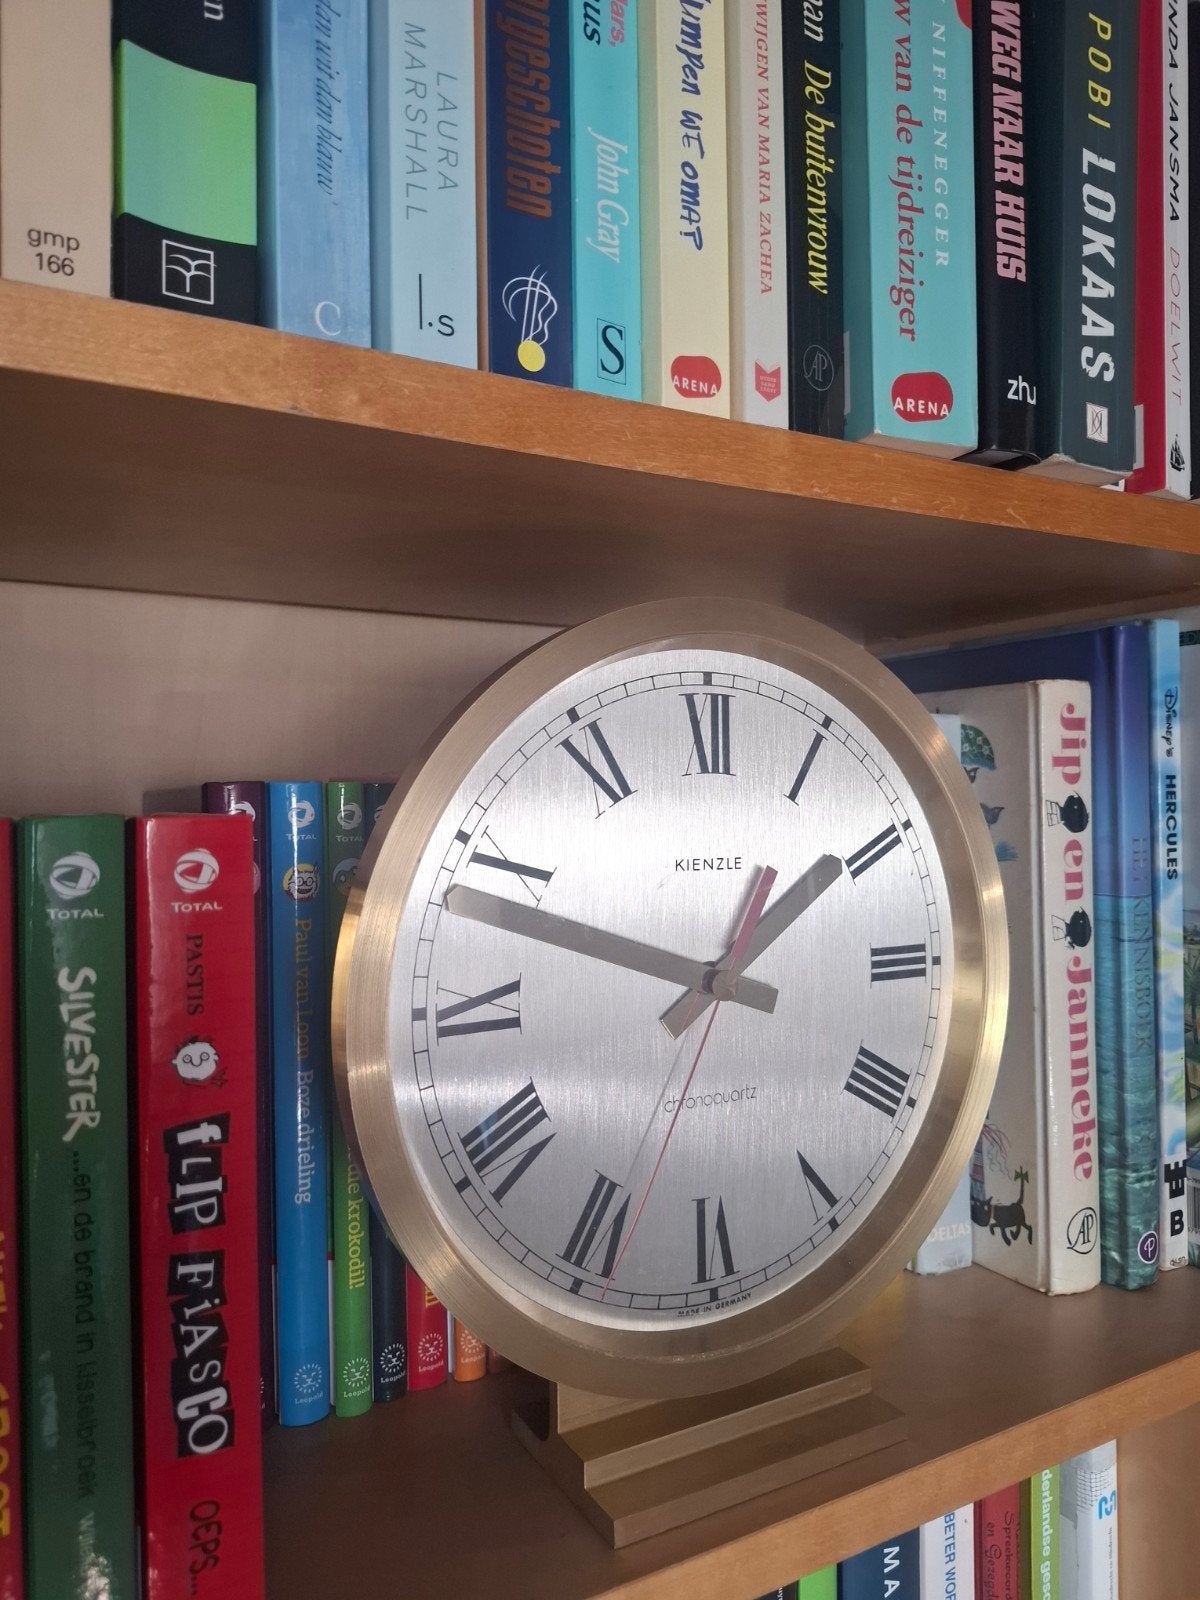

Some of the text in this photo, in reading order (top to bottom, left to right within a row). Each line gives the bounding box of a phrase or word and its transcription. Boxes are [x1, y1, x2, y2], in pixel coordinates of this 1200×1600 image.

[314, 0, 342, 39] dan
[583, 0, 601, 45] us
[804, 61, 831, 103] De
[895, 35, 912, 92] van
[1088, 13, 1111, 129] POBI
[314, 77, 343, 125] dan
[404, 22, 428, 221] MARSHALL
[895, 104, 922, 145] de
[437, 71, 459, 190] LAURA
[753, 0, 773, 295] WIJGEN VAN MARIA ZACHEA
[931, 21, 950, 268] NIFFENEGGER
[990, 1, 1027, 283] WEG NAAR HUIS
[1167, 84, 1180, 222] JANSMA
[586, 127, 629, 263] John Gray
[804, 103, 836, 295] buitenvrouw
[27, 228, 80, 252] gmp
[34, 252, 75, 277] 166
[889, 155, 925, 343] tijdreiziger
[1081, 148, 1116, 382] LOKAAS
[600, 324, 625, 375] S
[1168, 246, 1182, 406] DOELWIT
[672, 372, 720, 396] ARENA
[893, 395, 949, 418] ARENA
[678, 693, 736, 777] XII
[556, 716, 639, 819] XI
[286, 833, 317, 841] TOTAL
[1165, 774, 1179, 881] HERCULES
[674, 856, 743, 874] KIENZLE
[46, 907, 104, 921] TOTAL
[171, 901, 223, 913] TOTAL
[294, 918, 313, 963] Paul
[869, 942, 928, 988] III
[1052, 703, 1096, 1182] Jip en Janneke
[185, 933, 205, 1016] PASTIS
[296, 967, 310, 1004] van
[1132, 896, 1151, 1049] KENNISBOEK
[435, 972, 523, 1046] IX
[57, 966, 101, 1142] SILVESTER
[297, 1070, 314, 1119] Boze
[664, 1083, 757, 1113] chronoquartz
[294, 1121, 316, 1205] drieling
[457, 1076, 557, 1208] VIII
[73, 1211, 92, 1242] de
[347, 1196, 365, 1289] krokodil!
[555, 1169, 632, 1281] VII
[692, 1195, 740, 1285] VI
[74, 1249, 96, 1323] brand
[678, 1291, 751, 1318] MADE IN GERMANY
[75, 1330, 95, 1353] in
[418, 1360, 444, 1373] Leopold
[295, 1392, 324, 1405] Leopold
[343, 1386, 371, 1398] Leopold
[380, 1371, 406, 1384] Leopold
[944, 1512, 956, 1564] BETER
[986, 1522, 995, 1537] en
[1041, 1469, 1053, 1556] derlandse
